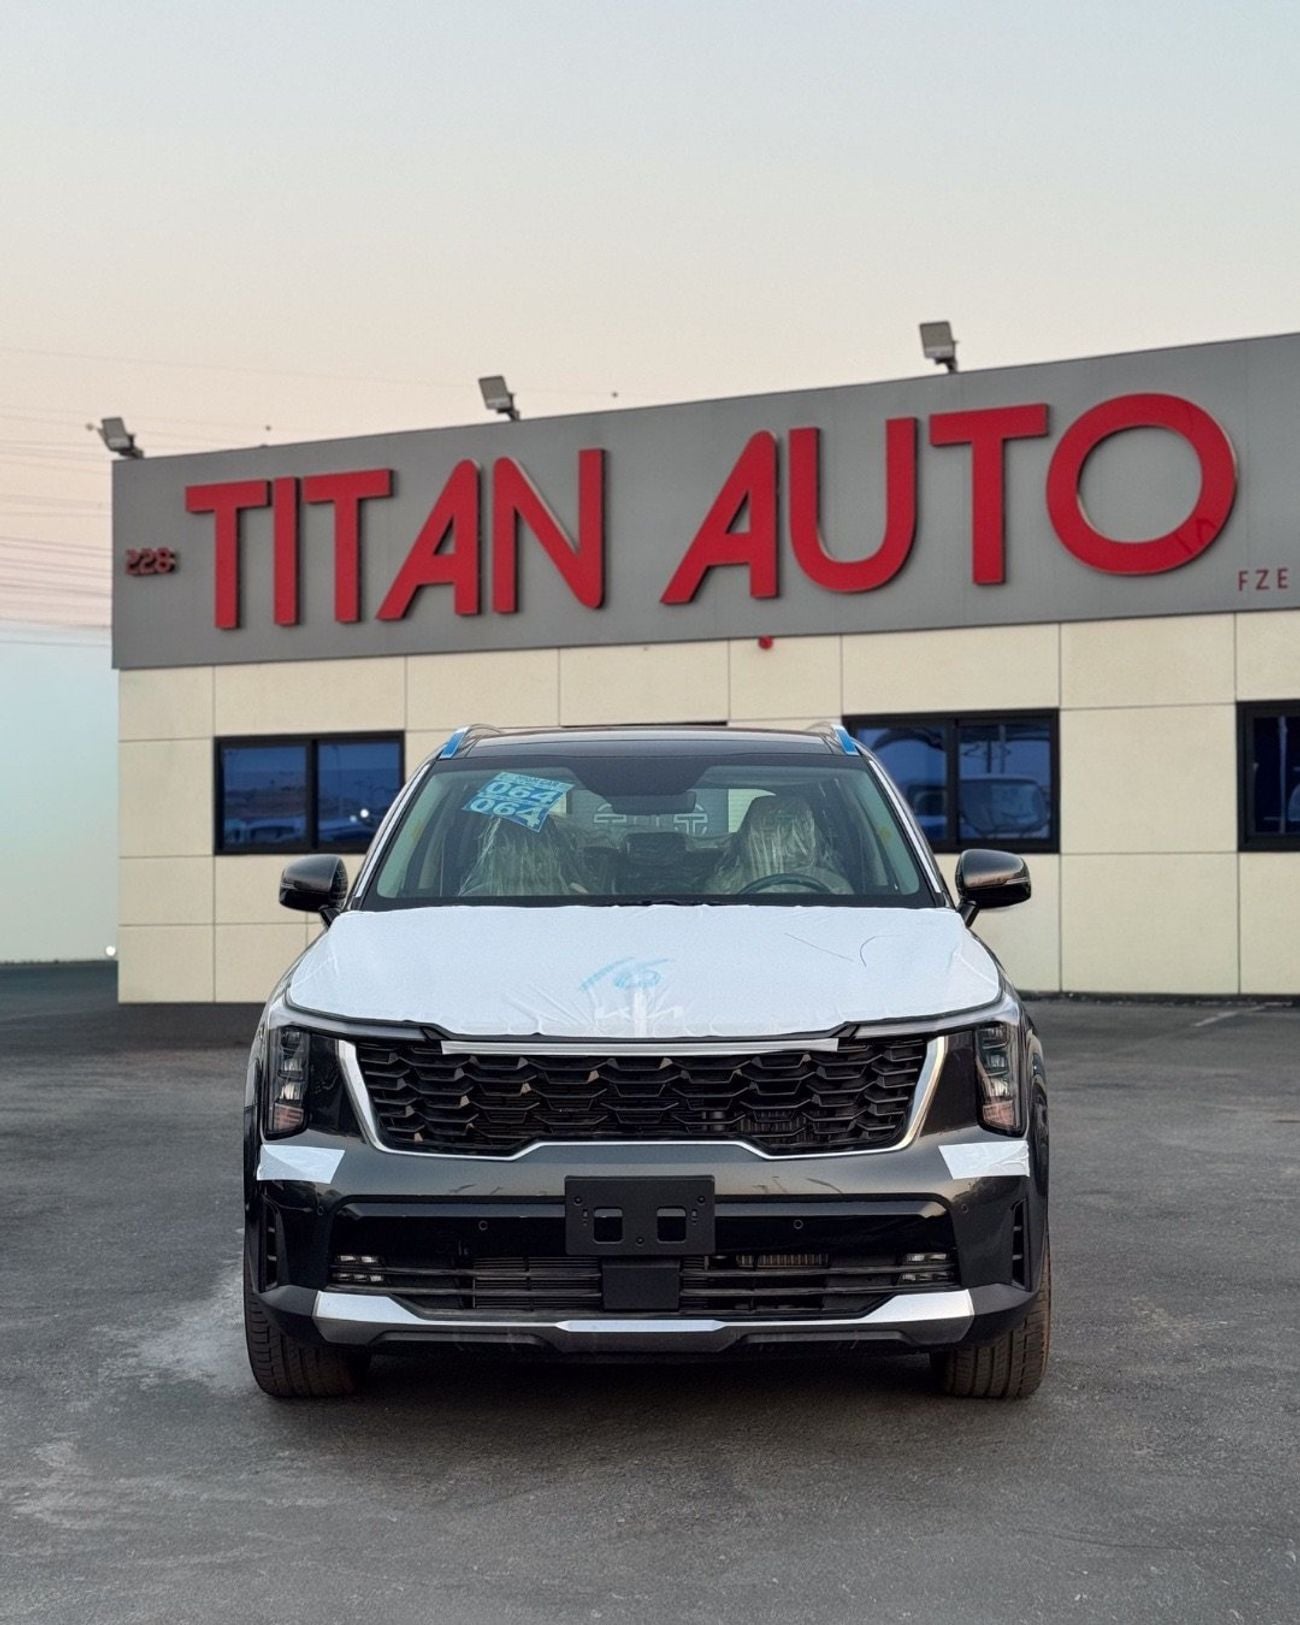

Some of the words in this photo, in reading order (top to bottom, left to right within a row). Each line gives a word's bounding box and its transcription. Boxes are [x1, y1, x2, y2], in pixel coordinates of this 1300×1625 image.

[185, 448, 605, 628] TITAN
[661, 392, 1238, 605] AUTO
[1238, 567, 1289, 592] FZE
[485, 781, 559, 804] 064
[469, 798, 543, 828] 064
